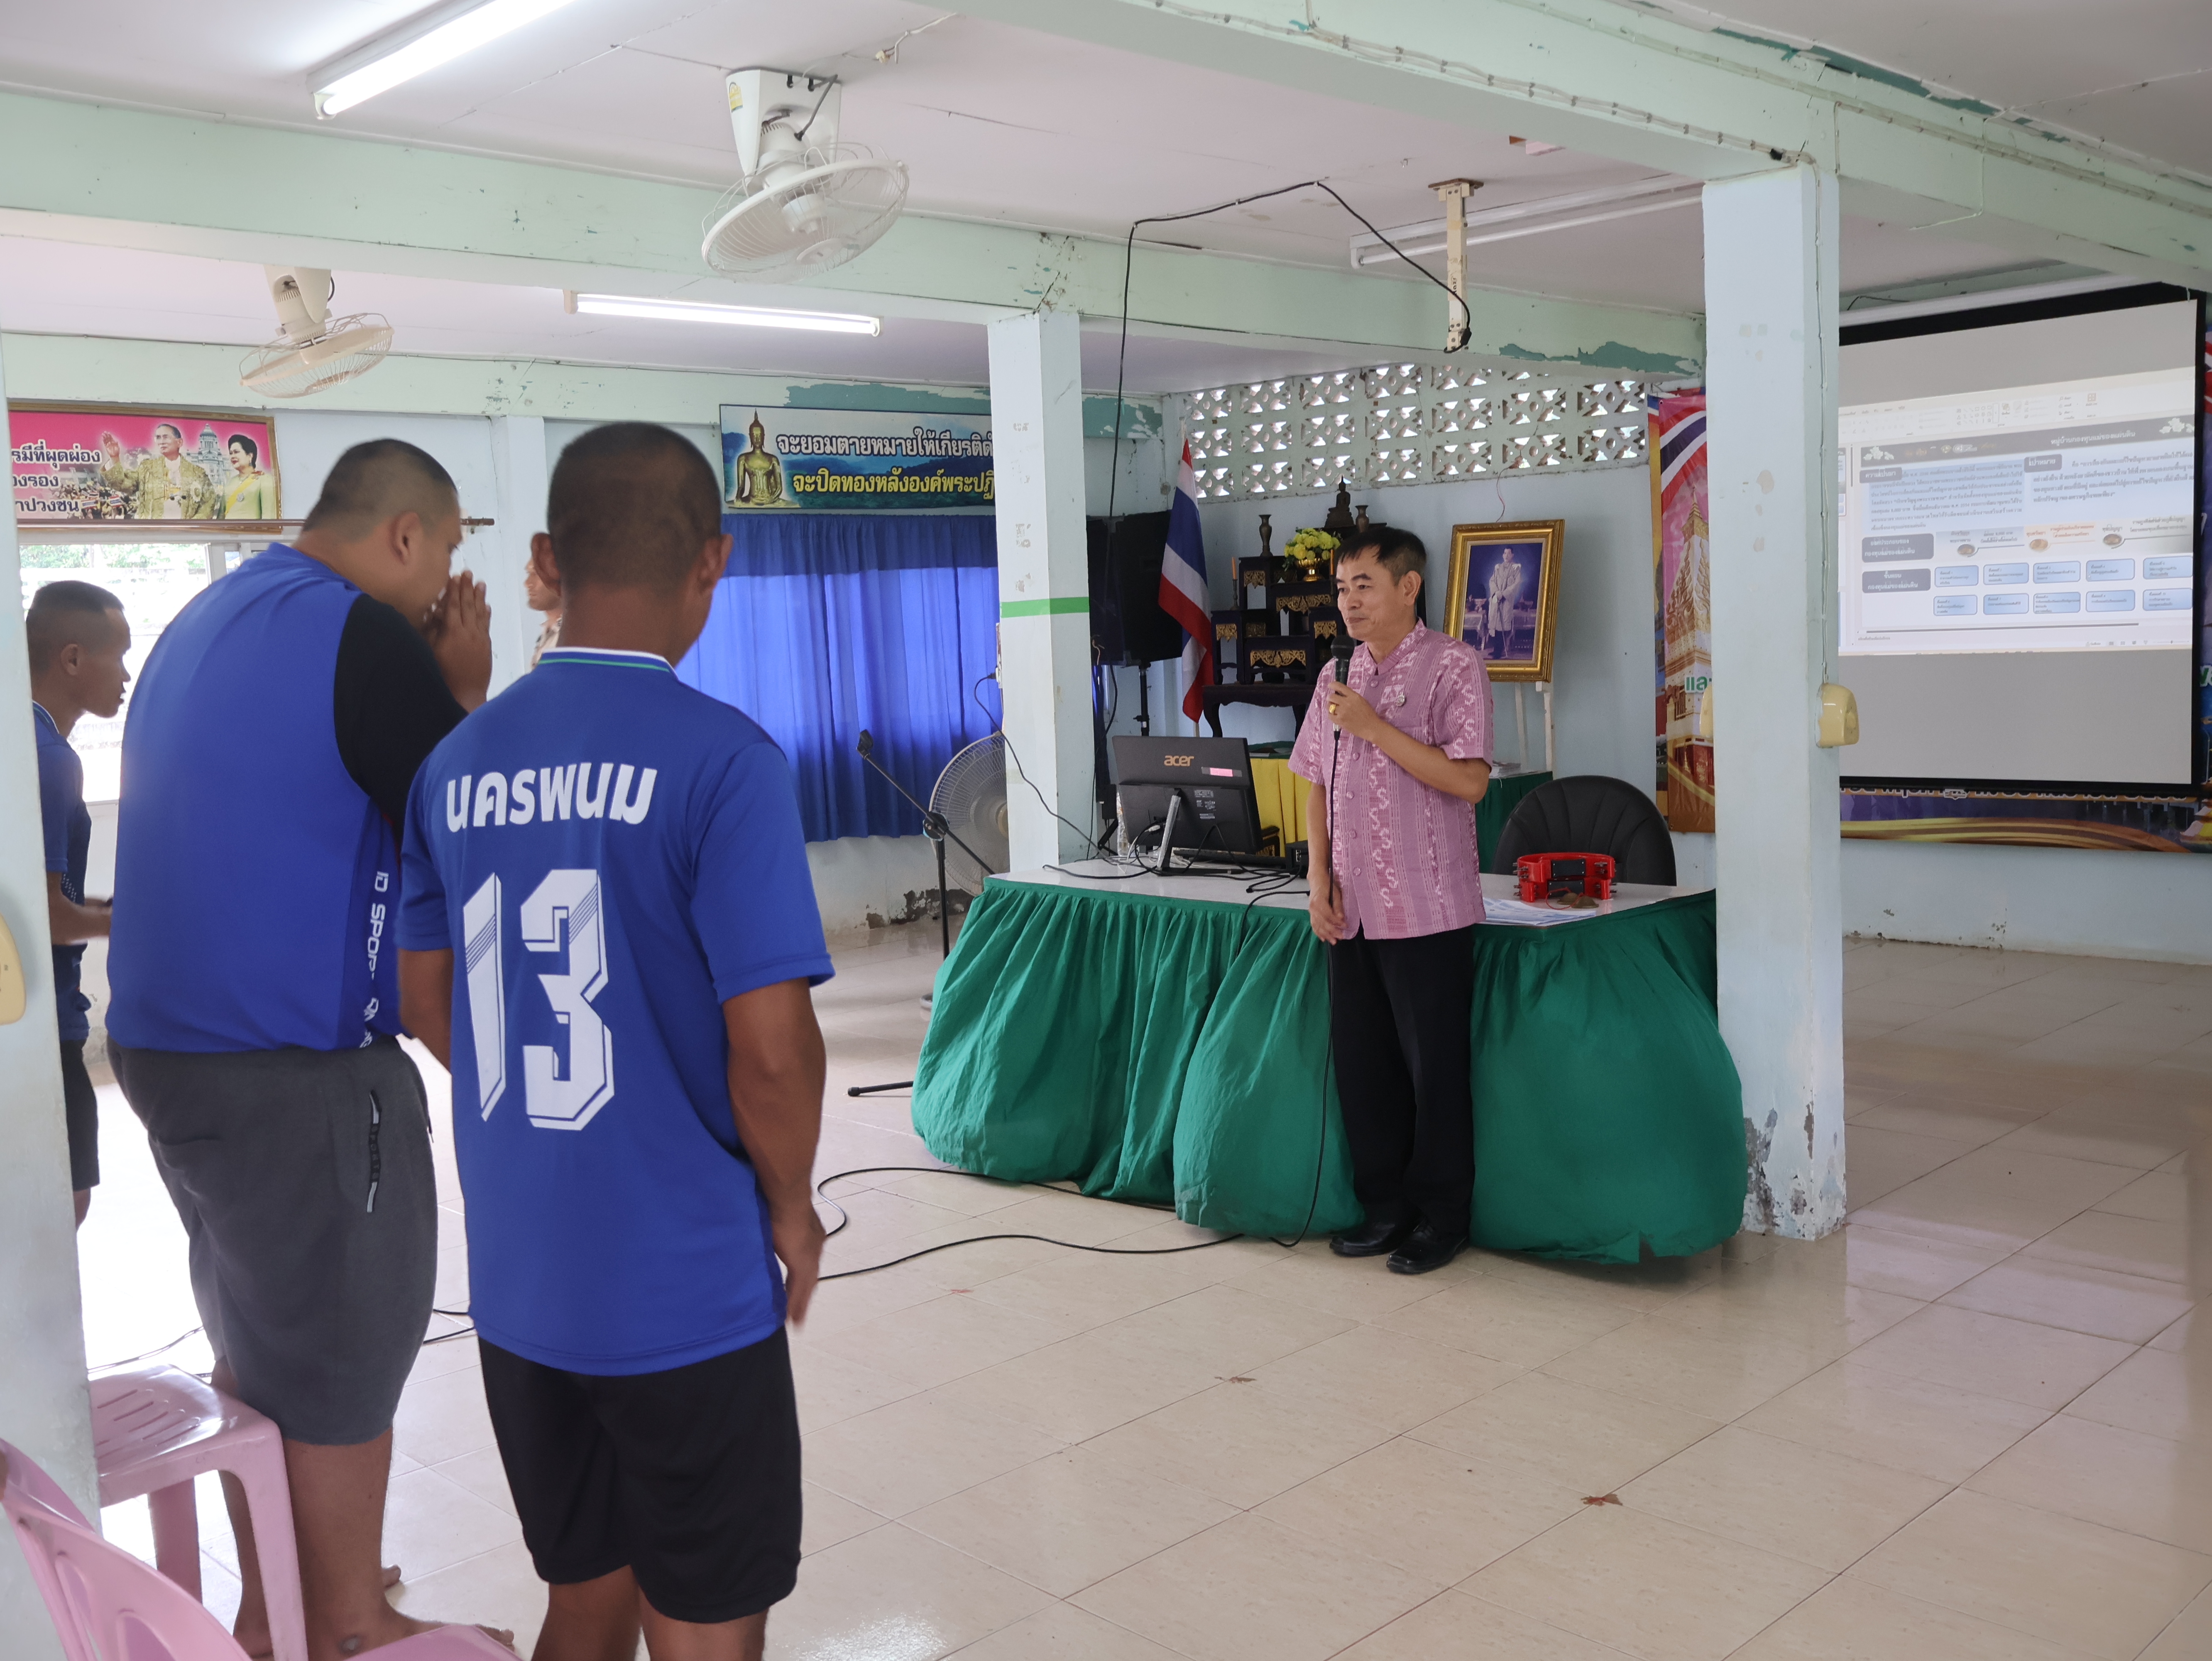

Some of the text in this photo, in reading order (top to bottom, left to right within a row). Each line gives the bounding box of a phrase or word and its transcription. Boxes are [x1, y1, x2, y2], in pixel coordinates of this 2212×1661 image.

[1686, 676, 1712, 691] แล
[1164, 755, 1194, 767] acer
[447, 763, 657, 832] นครพนม
[463, 869, 614, 1131] 13
